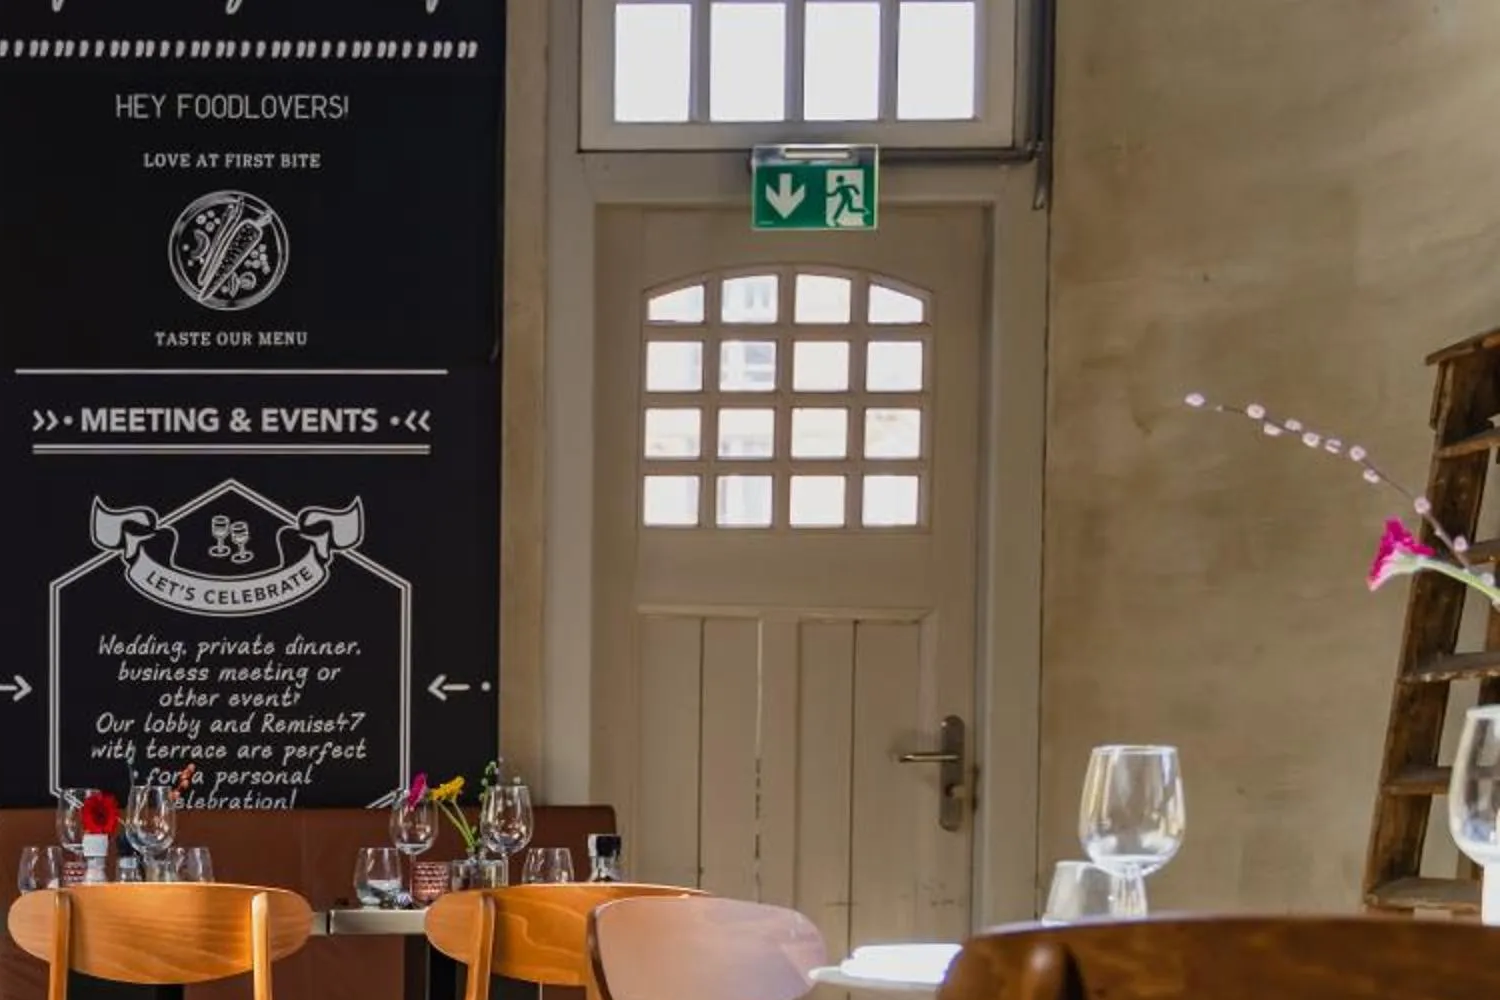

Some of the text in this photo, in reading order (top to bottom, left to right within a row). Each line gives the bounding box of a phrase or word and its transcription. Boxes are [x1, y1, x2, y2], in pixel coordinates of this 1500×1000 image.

[116, 94, 349, 119] HEY FOODLOVERS!
[143, 152, 321, 168] LOVE AT FIRST BITE
[155, 331, 308, 347] TASTE OUR MENU
[80, 407, 379, 433] MEETING & EVENTS
[146, 566, 314, 605] LET'S CELEBRATE
[196, 634, 276, 663] private
[117, 660, 341, 688] business meeting or
[159, 686, 220, 707] other
[95, 711, 367, 739] Our lobby and Remise47
[91, 738, 367, 765] with terrace are perfect
[147, 764, 314, 791] for a personal
[173, 789, 298, 809] elebration!
